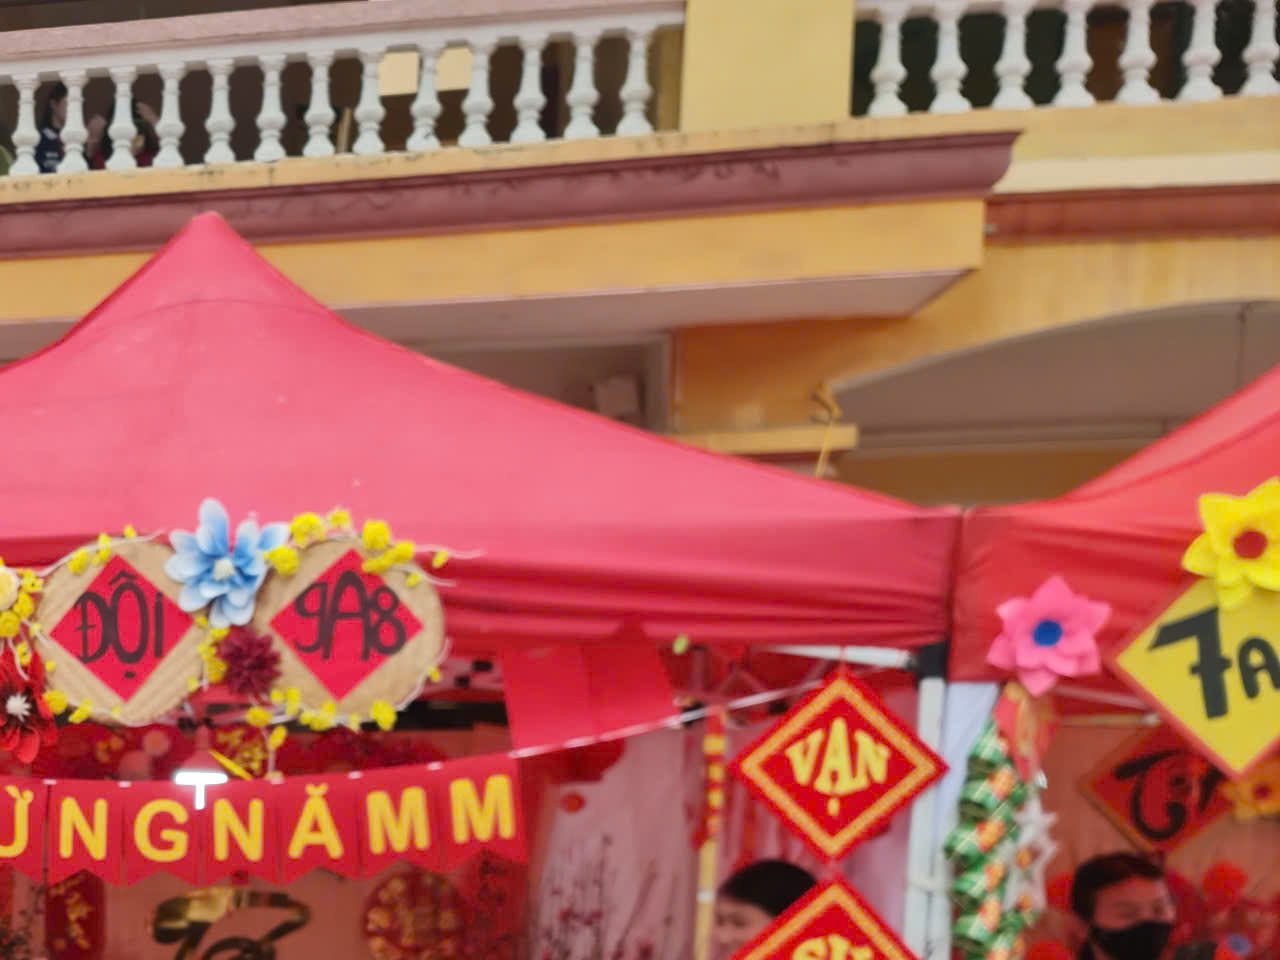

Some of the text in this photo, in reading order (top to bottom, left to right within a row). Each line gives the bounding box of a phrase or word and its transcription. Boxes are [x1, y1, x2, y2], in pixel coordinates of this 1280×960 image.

[293, 569, 407, 662] 9A8
[785, 717, 890, 816] VẠN
[213, 783, 432, 862] NĂM
